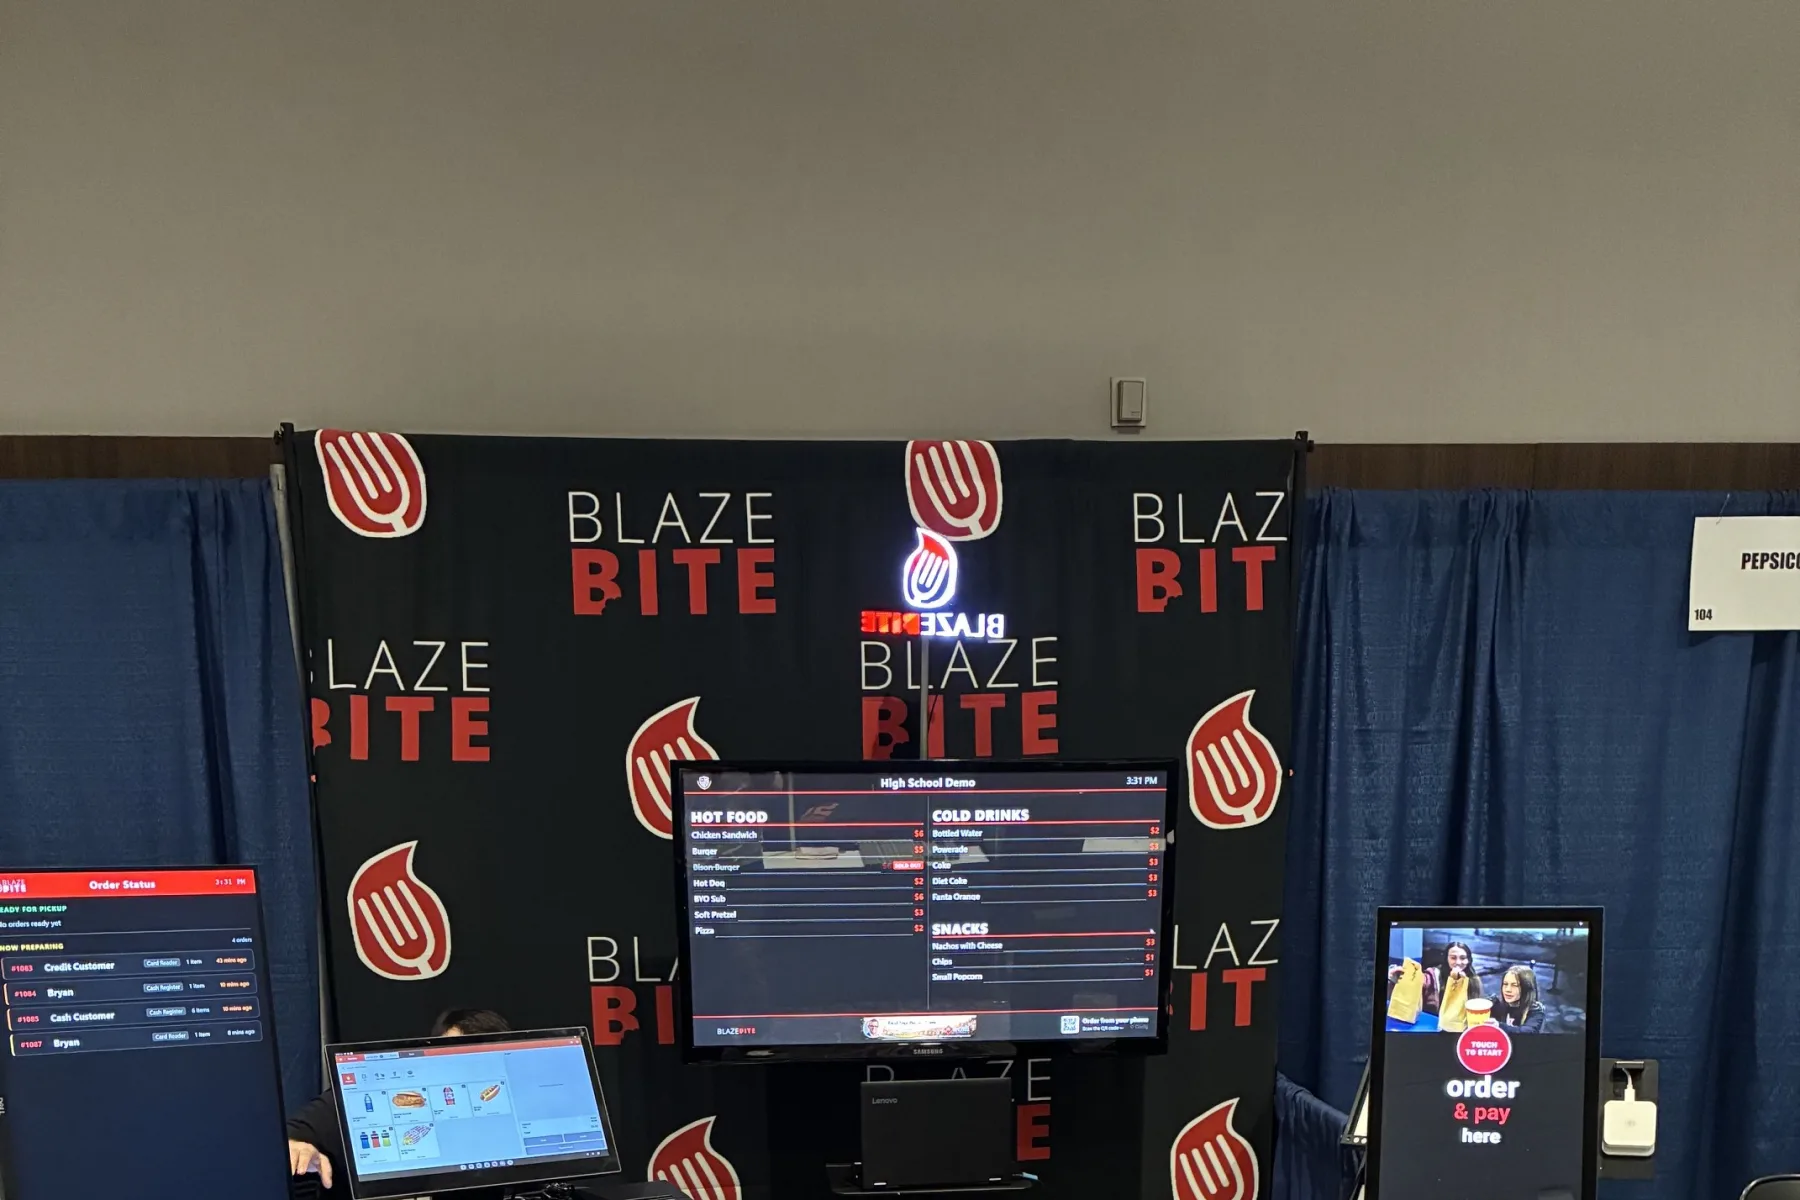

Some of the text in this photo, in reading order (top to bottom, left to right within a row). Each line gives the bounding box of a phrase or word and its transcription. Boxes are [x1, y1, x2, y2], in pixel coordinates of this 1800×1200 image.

[567, 491, 775, 544] BLAZE
[1132, 491, 1287, 543] BLAZ
[571, 548, 776, 615] BITE
[1136, 545, 1276, 613] BIT
[1694, 608, 1713, 620] 104
[310, 639, 490, 692] LAZE
[860, 636, 1059, 690] BLAZE
[861, 691, 1059, 760] BITE
[880, 778, 976, 790] High School Demo
[1126, 776, 1158, 785] 3:31 PM
[691, 811, 768, 824] HOT FOOD
[932, 808, 1030, 823] COLD DRINKS
[691, 831, 757, 840] Chicken Sandwich
[914, 829, 924, 838] $6
[932, 829, 983, 839] Bottled Water
[1150, 826, 1160, 835] $2
[914, 845, 924, 854] $5
[932, 845, 968, 855] Powerade
[1149, 842, 1159, 850] $3
[692, 847, 718, 857] Burger
[932, 861, 951, 870] Coke
[1149, 858, 1159, 867] $3
[716, 863, 740, 873] Burger
[215, 877, 247, 886] 3:31 PM
[914, 877, 924, 886] $2
[932, 877, 968, 886] Diet Coke
[1148, 873, 1158, 882] $3
[89, 879, 156, 890] Order Status
[693, 879, 726, 889] Hot Dog
[694, 894, 726, 903] BYO Sub
[914, 893, 924, 901] $6
[932, 893, 981, 903] Fanta Orange
[1148, 889, 1157, 898] $3
[694, 910, 737, 919] Soft Pretzel
[914, 908, 924, 917] $3
[8, 920, 30, 928] orders
[31, 920, 49, 928] ready
[50, 920, 62, 928] yet
[914, 924, 924, 932] $2
[695, 926, 715, 936] Pizza
[932, 923, 989, 936] SNACKS
[21, 943, 64, 951] PREPARING
[932, 941, 1003, 951] Nachos with Cheese
[1146, 938, 1155, 946] $3
[1173, 918, 1280, 970] LAZ
[932, 957, 952, 967] Chips
[1145, 953, 1154, 962] $1
[11, 962, 115, 972] #1083 Credit Customer
[932, 972, 983, 982] Small Popcorn
[1145, 969, 1154, 977] $1
[47, 988, 74, 998] Bryan
[1169, 967, 1267, 1031] IT
[50, 1013, 71, 1022] Cash
[73, 1012, 115, 1021] Customer
[590, 985, 675, 1045] BI
[1082, 1017, 1099, 1025] Order
[1130, 1016, 1149, 1025] phone
[53, 1039, 80, 1048] Bryan
[1471, 1041, 1498, 1049] TOUCH
[1446, 1075, 1520, 1099] order
[1454, 1104, 1511, 1125] & pay
[1461, 1127, 1501, 1144] here
